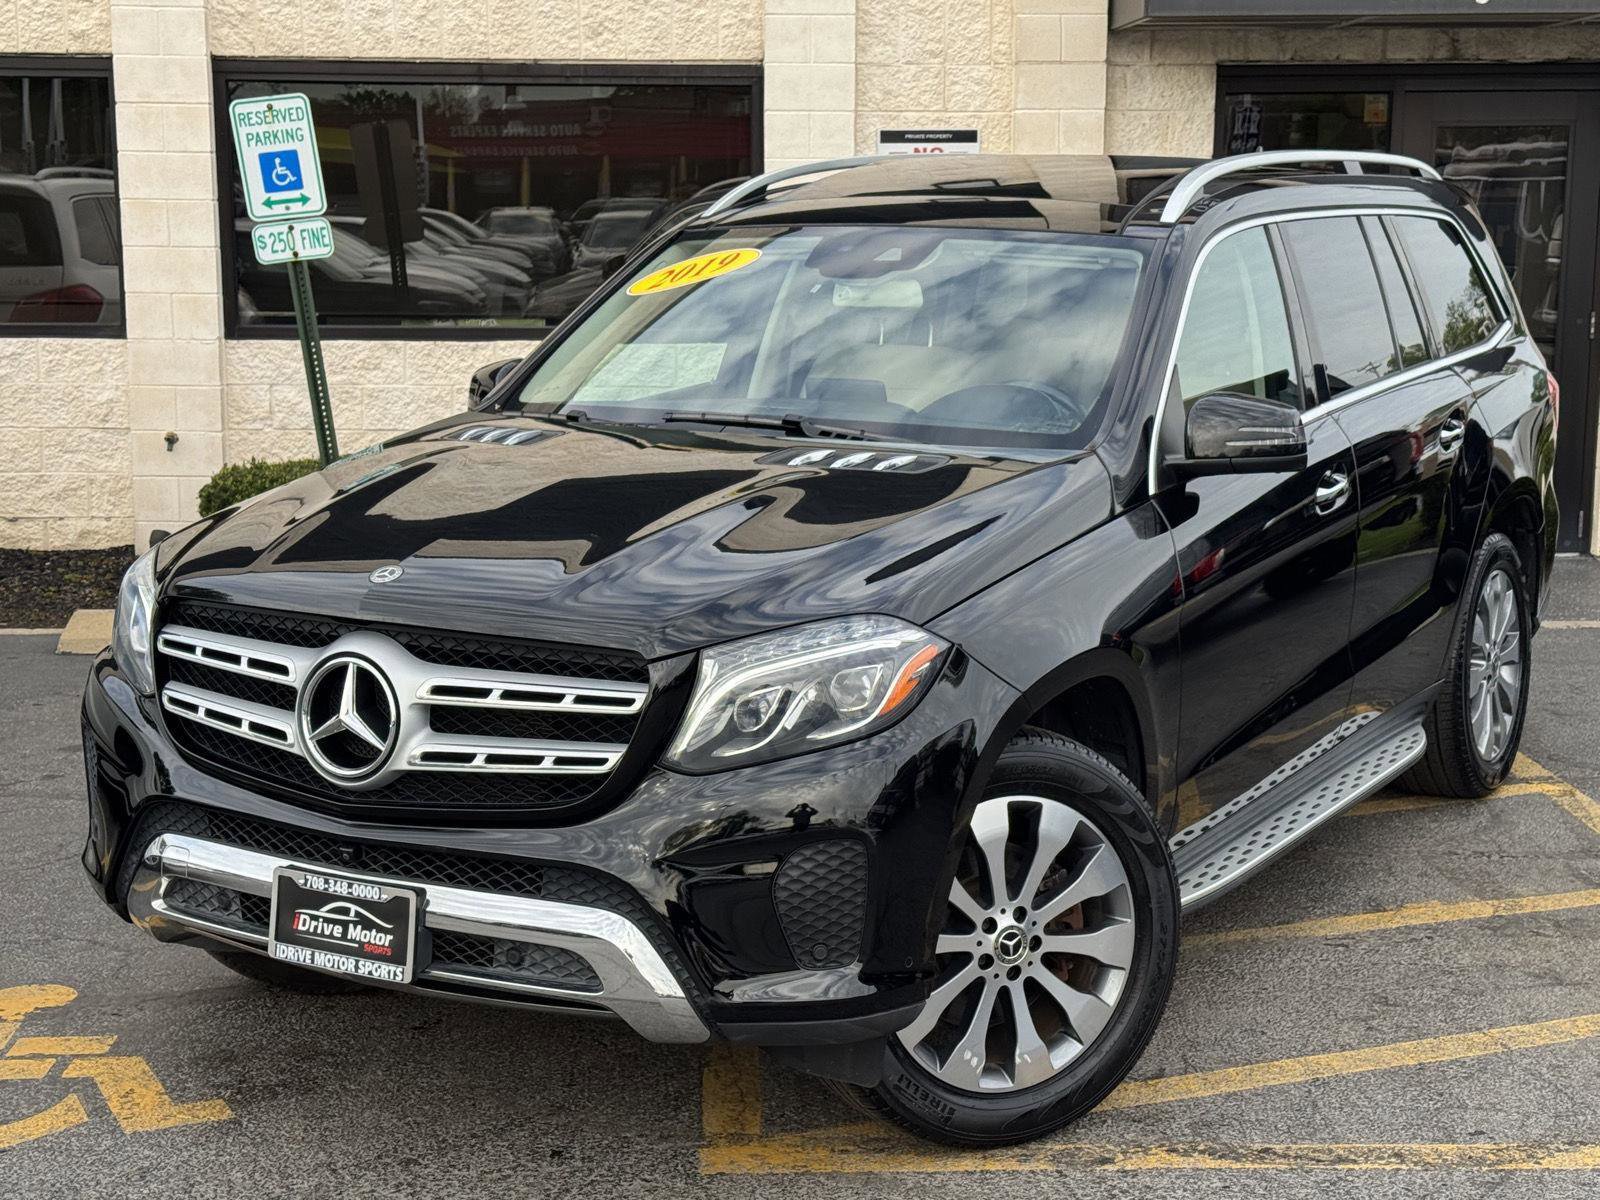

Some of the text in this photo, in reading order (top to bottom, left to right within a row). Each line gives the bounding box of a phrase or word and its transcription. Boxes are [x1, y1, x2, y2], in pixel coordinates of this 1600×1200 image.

[238, 106, 304, 128] RESERVED
[246, 127, 304, 147] PARKING
[300, 226, 330, 249] FINE
[648, 252, 741, 289] 2019
[305, 875, 381, 900] 708-348-0000
[293, 911, 394, 947] iDrive Motor
[363, 943, 392, 956] SPORTS
[314, 951, 357, 974] MOTOR
[358, 960, 404, 982] SPORTS
[894, 1073, 957, 1125] PIRELLI
